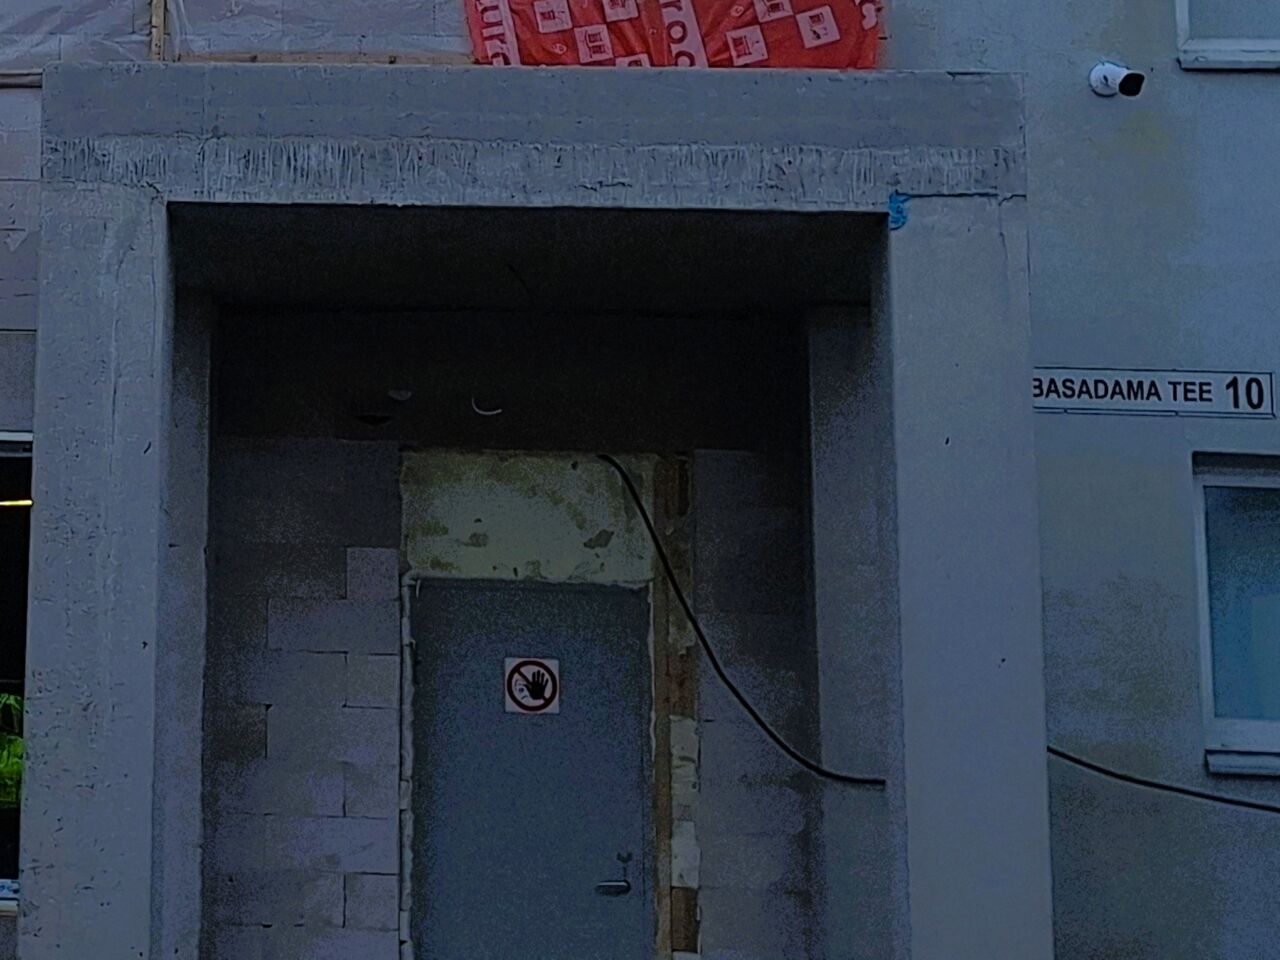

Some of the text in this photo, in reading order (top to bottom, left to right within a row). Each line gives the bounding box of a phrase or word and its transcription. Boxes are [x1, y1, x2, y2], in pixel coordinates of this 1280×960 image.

[1032, 375, 1265, 410] BASADAMA TEE 10
